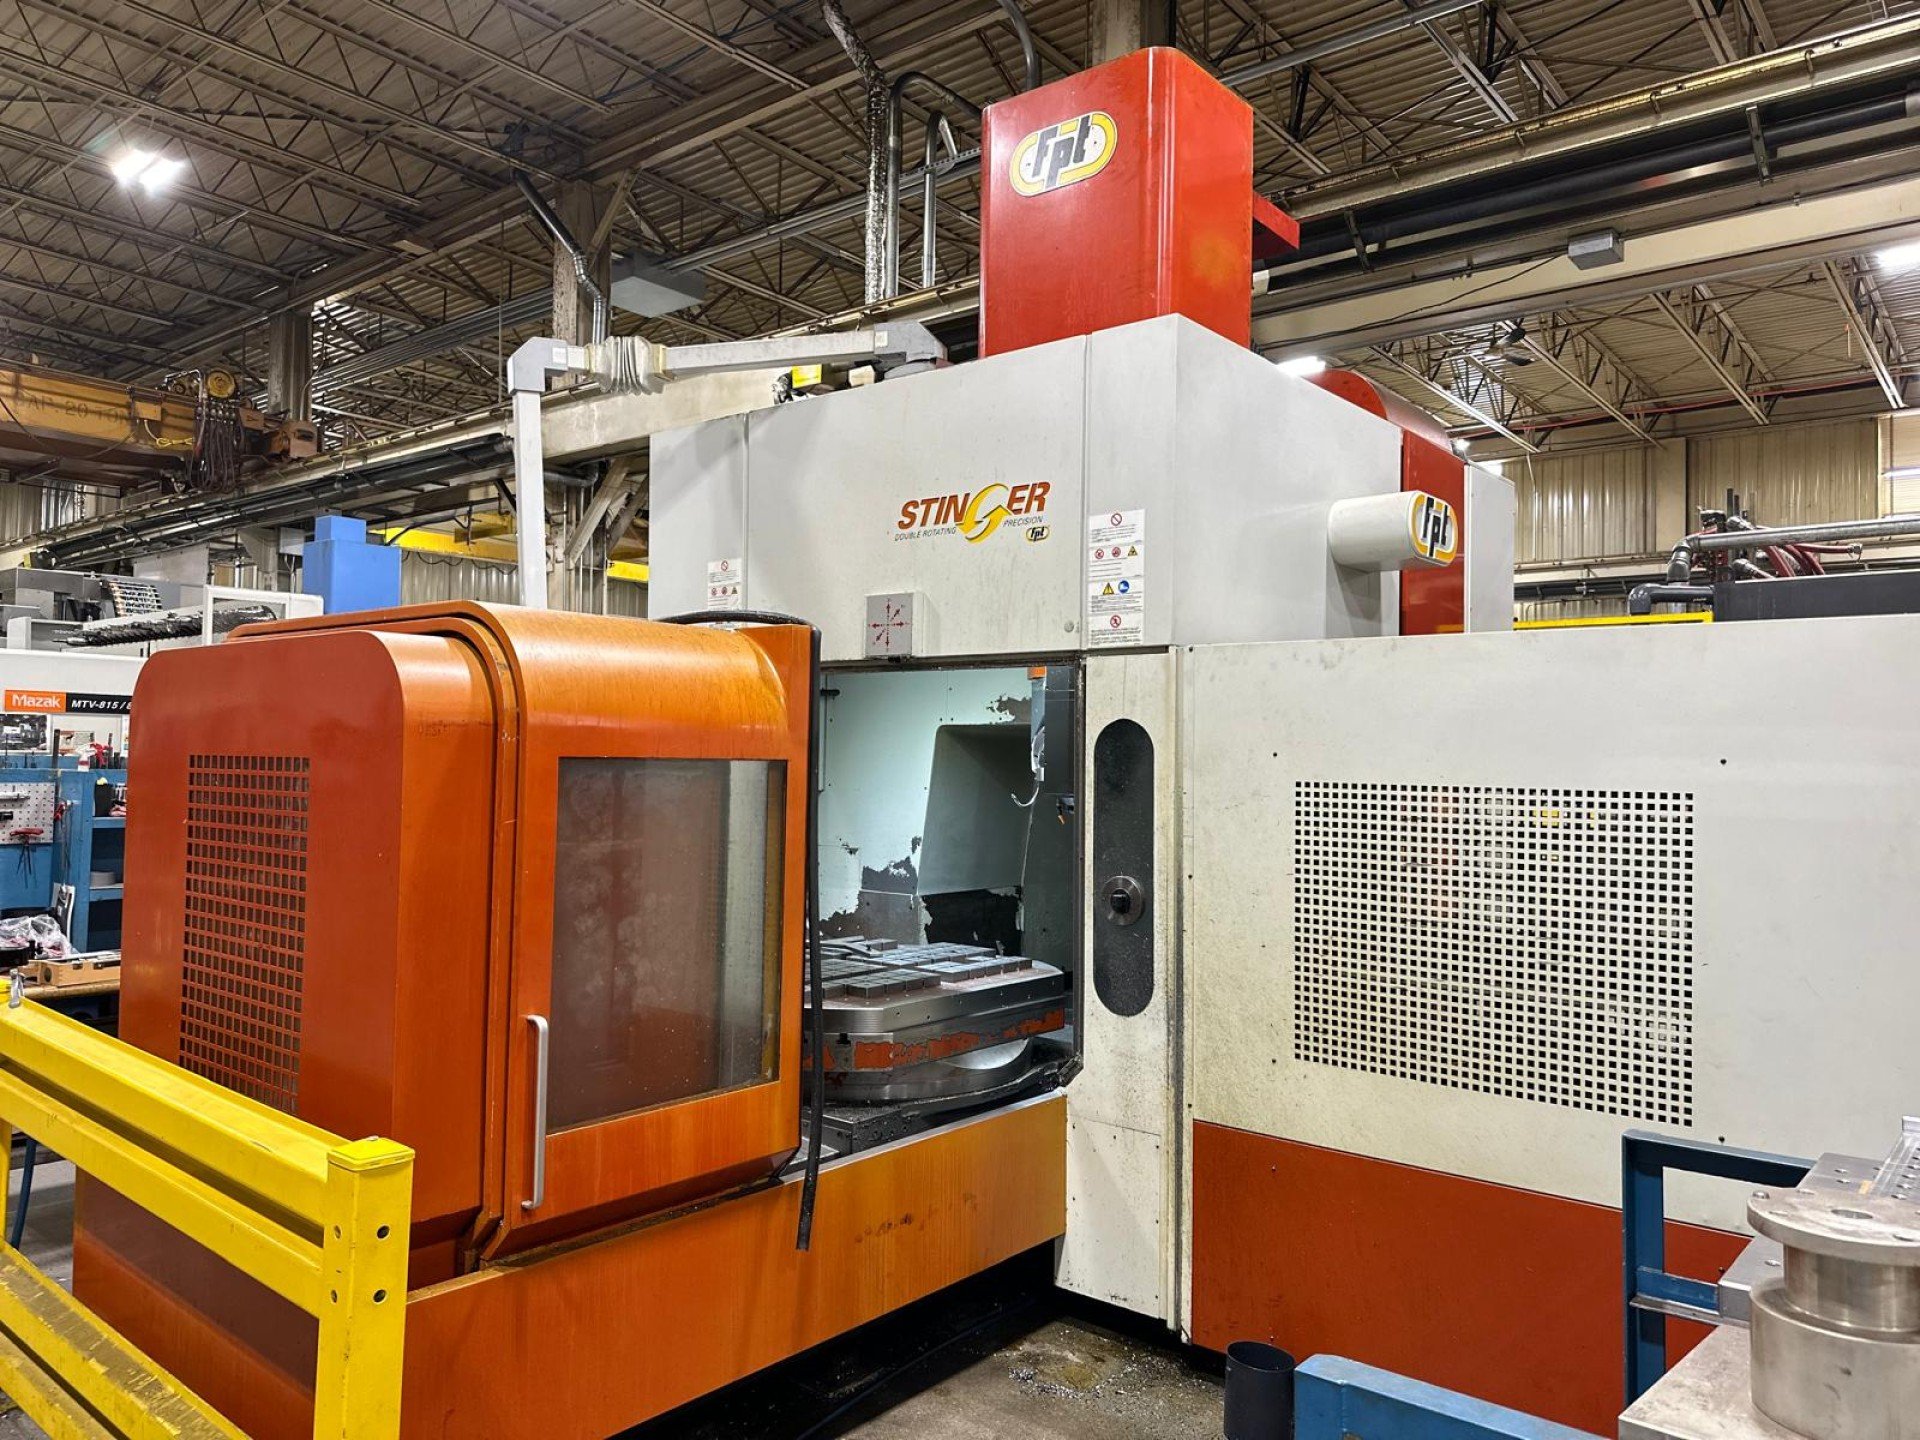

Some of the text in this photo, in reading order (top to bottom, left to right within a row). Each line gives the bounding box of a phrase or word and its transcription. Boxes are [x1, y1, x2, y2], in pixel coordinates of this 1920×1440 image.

[898, 482, 1050, 537] STINGER
[1003, 516, 1043, 527] PRECISION
[894, 527, 956, 541] DOUBLE ROTATING
[12, 694, 61, 708] Mazak
